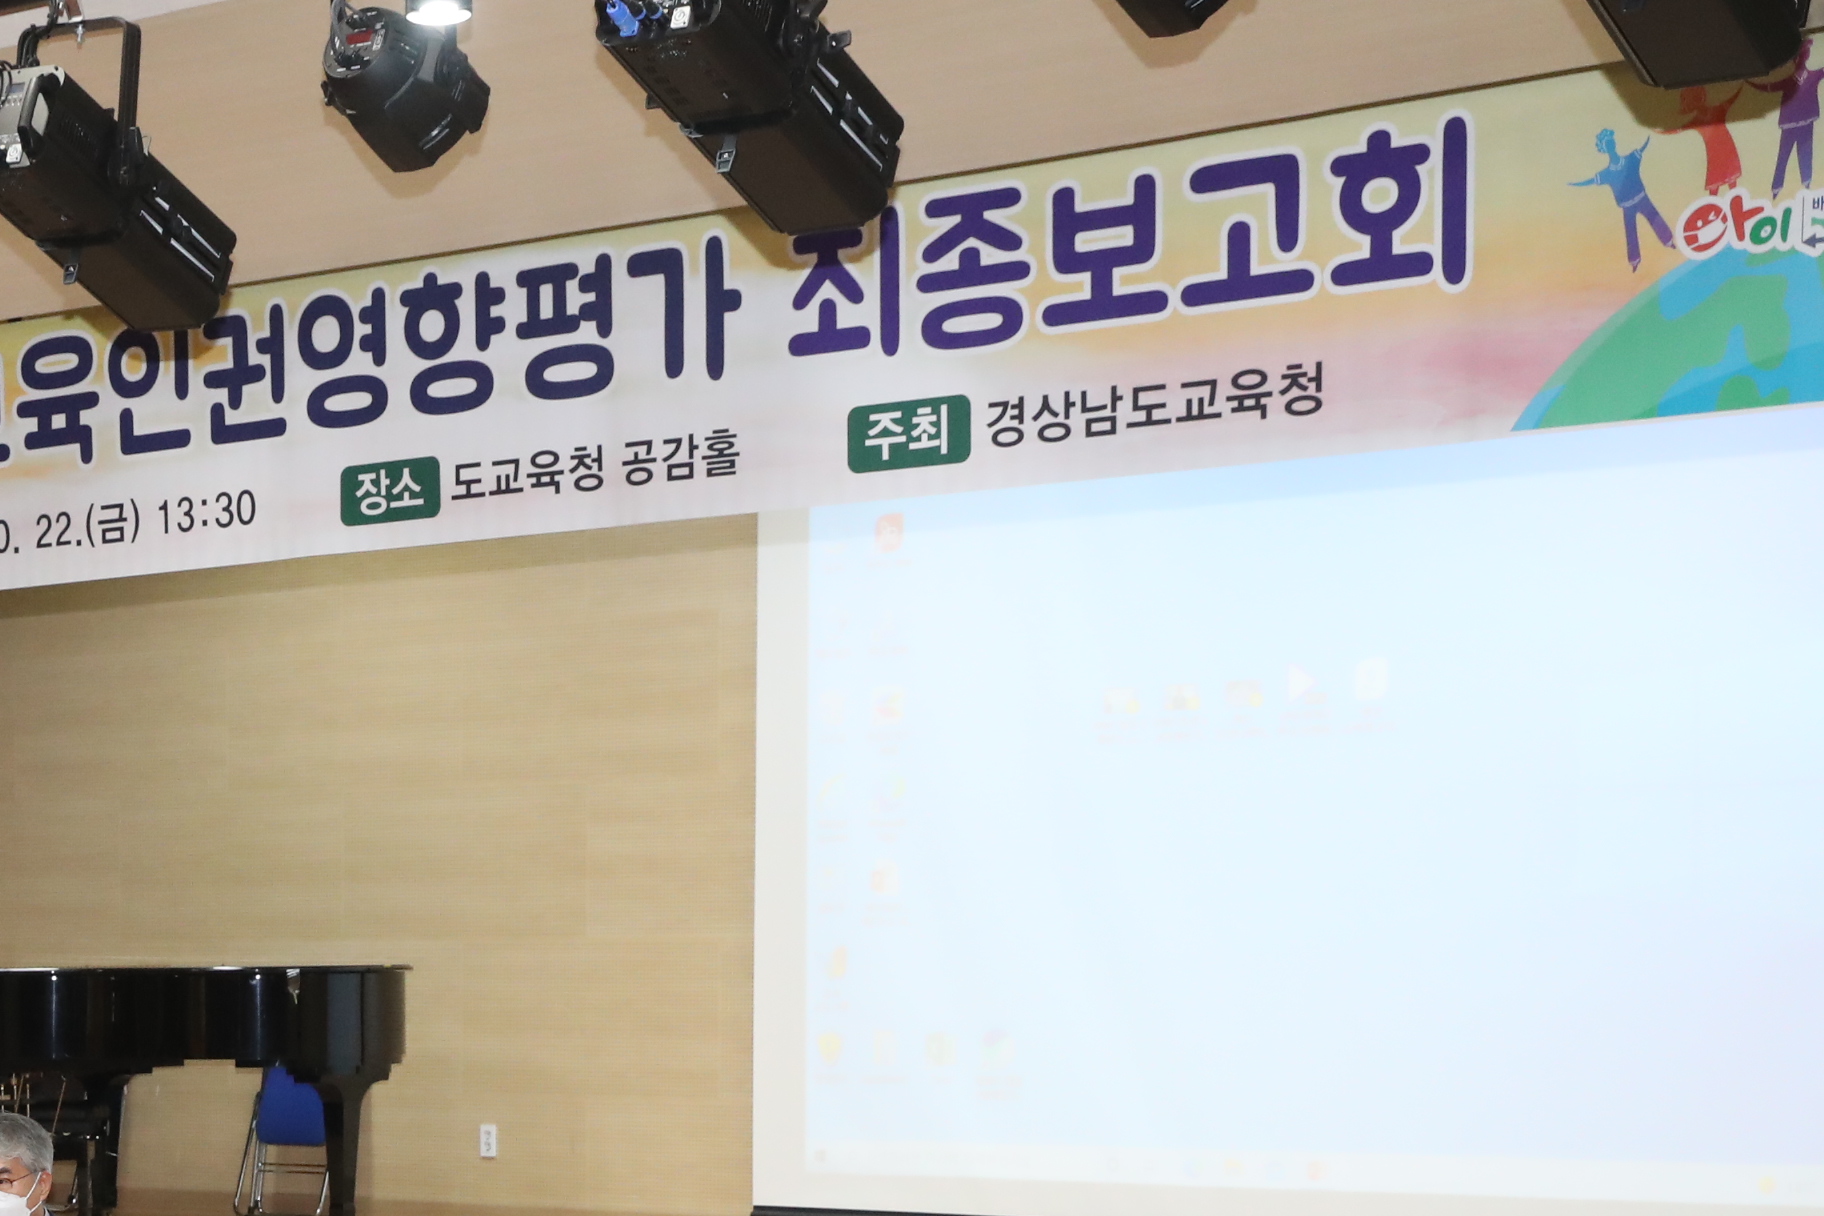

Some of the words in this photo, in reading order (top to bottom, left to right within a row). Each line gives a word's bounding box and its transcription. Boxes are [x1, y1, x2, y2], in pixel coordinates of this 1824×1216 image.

[864, 403, 950, 462] 주최
[985, 361, 1325, 448] 경상남도교육청
[159, 488, 257, 535] 13:30
[355, 468, 425, 516] 장소
[450, 444, 604, 501] 도교육청
[621, 427, 741, 487] 공감홀
